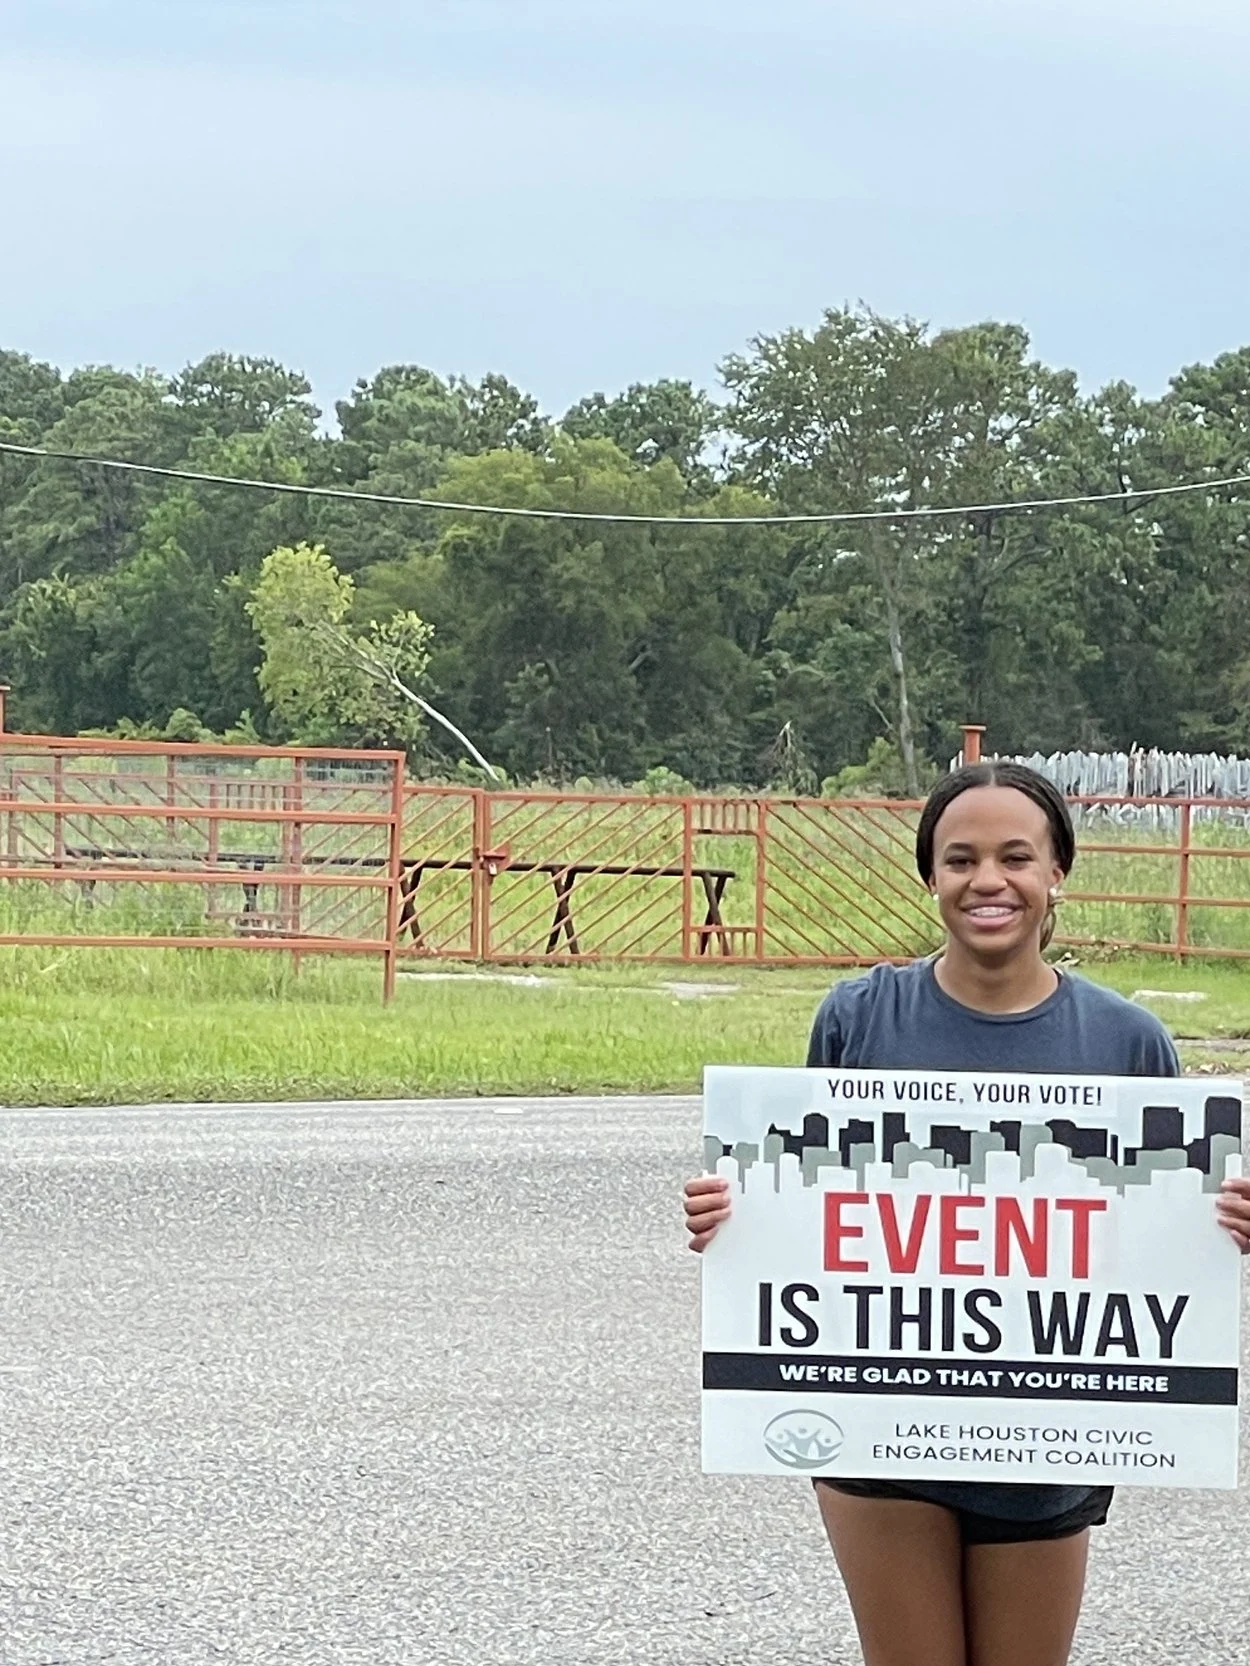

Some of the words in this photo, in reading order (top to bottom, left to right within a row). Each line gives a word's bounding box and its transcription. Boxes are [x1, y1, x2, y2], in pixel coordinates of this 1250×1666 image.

[827, 1079, 884, 1100] YOUR
[893, 1080, 964, 1103] VOICE,
[973, 1083, 1030, 1104] YOUR
[1039, 1085, 1101, 1106] VOTE!
[823, 1191, 1108, 1280] EVENT
[758, 1282, 820, 1348] IS
[842, 1284, 1003, 1354] THIS
[1026, 1290, 1191, 1360] WAY
[779, 1364, 858, 1383] WE'RE
[862, 1366, 932, 1385] GLAD
[935, 1369, 1004, 1387] THAT
[1007, 1371, 1101, 1390] YOU'RE
[1106, 1374, 1169, 1393] HERE
[895, 1423, 950, 1439] LAKE
[959, 1425, 1083, 1445] HOUSTON
[1088, 1427, 1154, 1446] CIVIC
[873, 1444, 1037, 1464] ENGAGEMENT
[1045, 1449, 1175, 1468] COALITION
